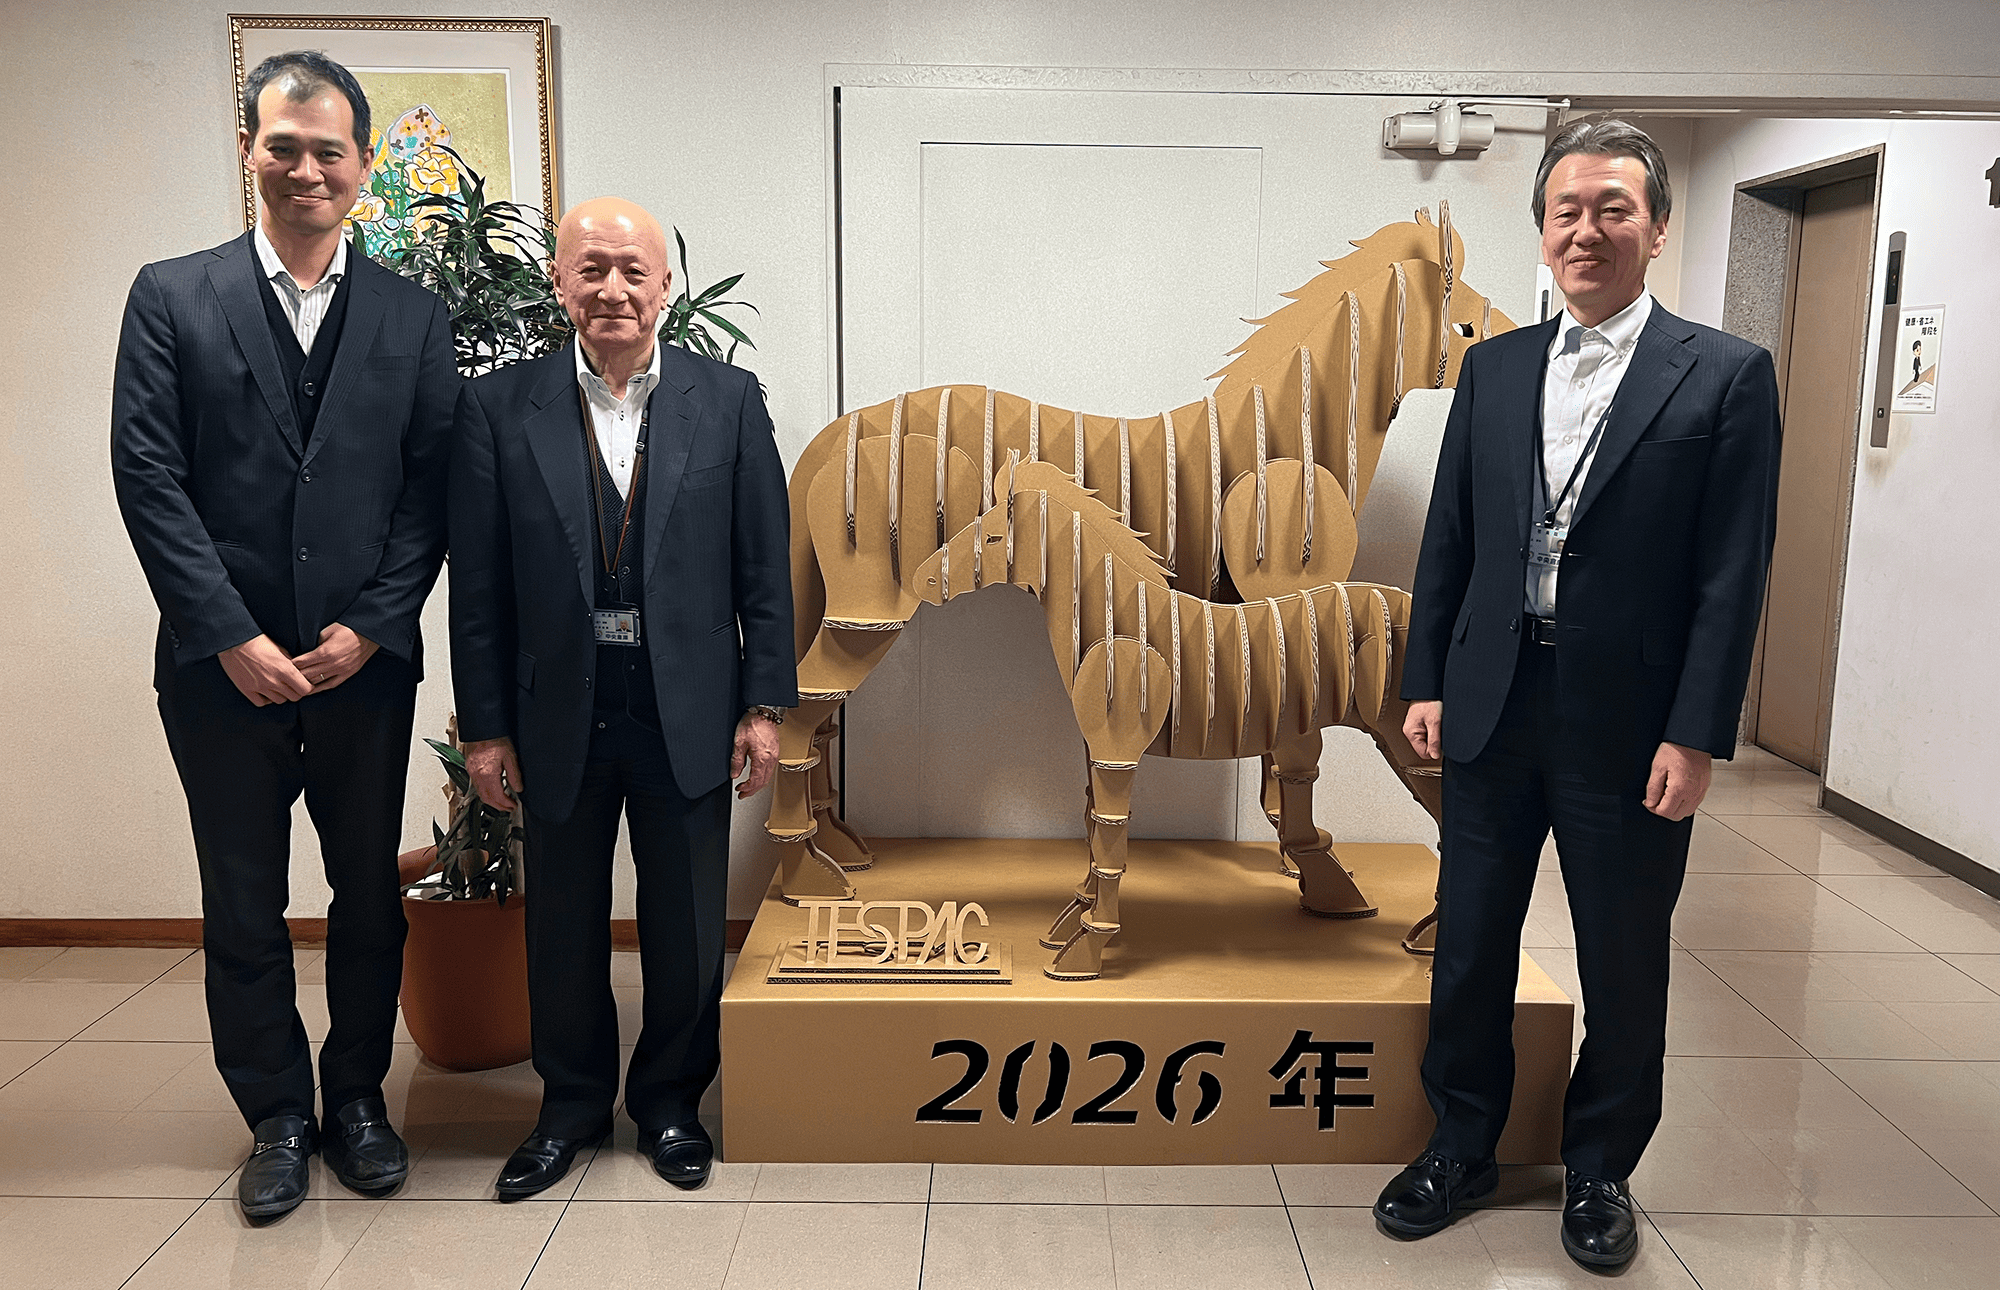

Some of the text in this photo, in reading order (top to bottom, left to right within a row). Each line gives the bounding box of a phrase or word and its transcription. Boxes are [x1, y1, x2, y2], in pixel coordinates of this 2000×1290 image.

[798, 900, 989, 964] TESPAC
[914, 1029, 1376, 1132] 2026 年
